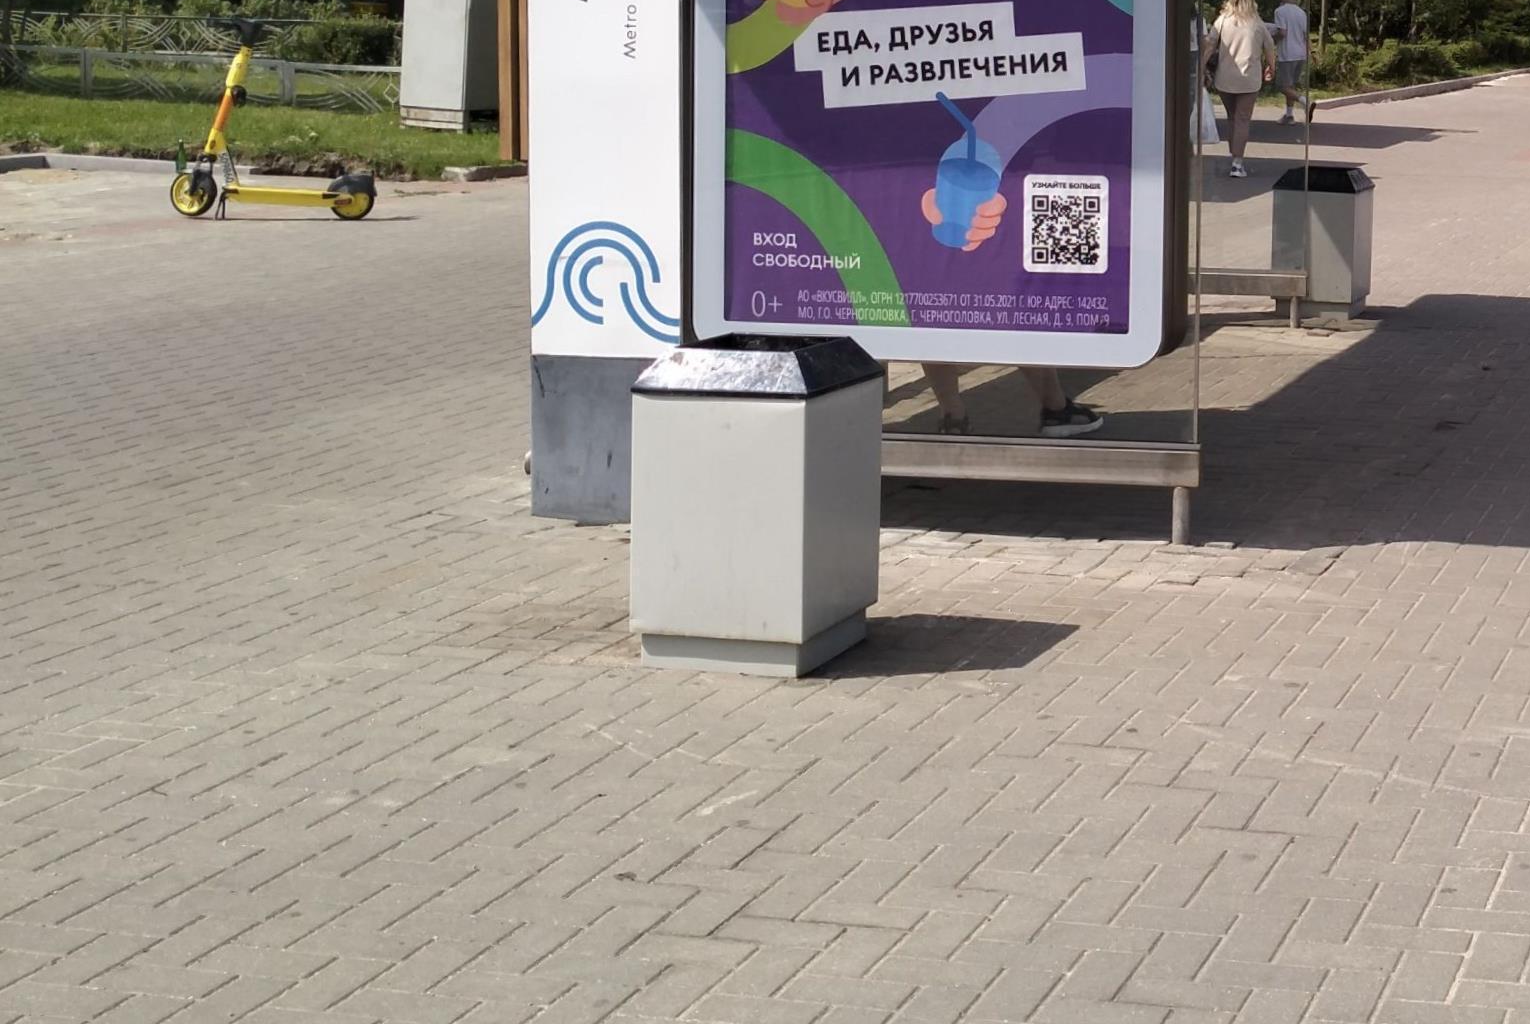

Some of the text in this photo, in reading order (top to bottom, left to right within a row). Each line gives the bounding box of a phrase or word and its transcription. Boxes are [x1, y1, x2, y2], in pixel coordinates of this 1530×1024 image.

[623, 3, 637, 59] Metro
[817, 20, 995, 56] ЕДА, ДРУЗЬЯ
[841, 51, 1068, 87] И РАЗВЛЕЧЕНИЯ
[1031, 181, 1067, 189] УЗНАЙТЕ
[753, 232, 797, 249] ВХОД
[752, 252, 861, 270] СВОБОДНЫЙ
[751, 290, 783, 318] 0+
[797, 290, 809, 302] АО
[871, 292, 893, 304] ОГРН
[960, 294, 971, 306] ОТ
[973, 294, 1016, 307] 31.05.2021
